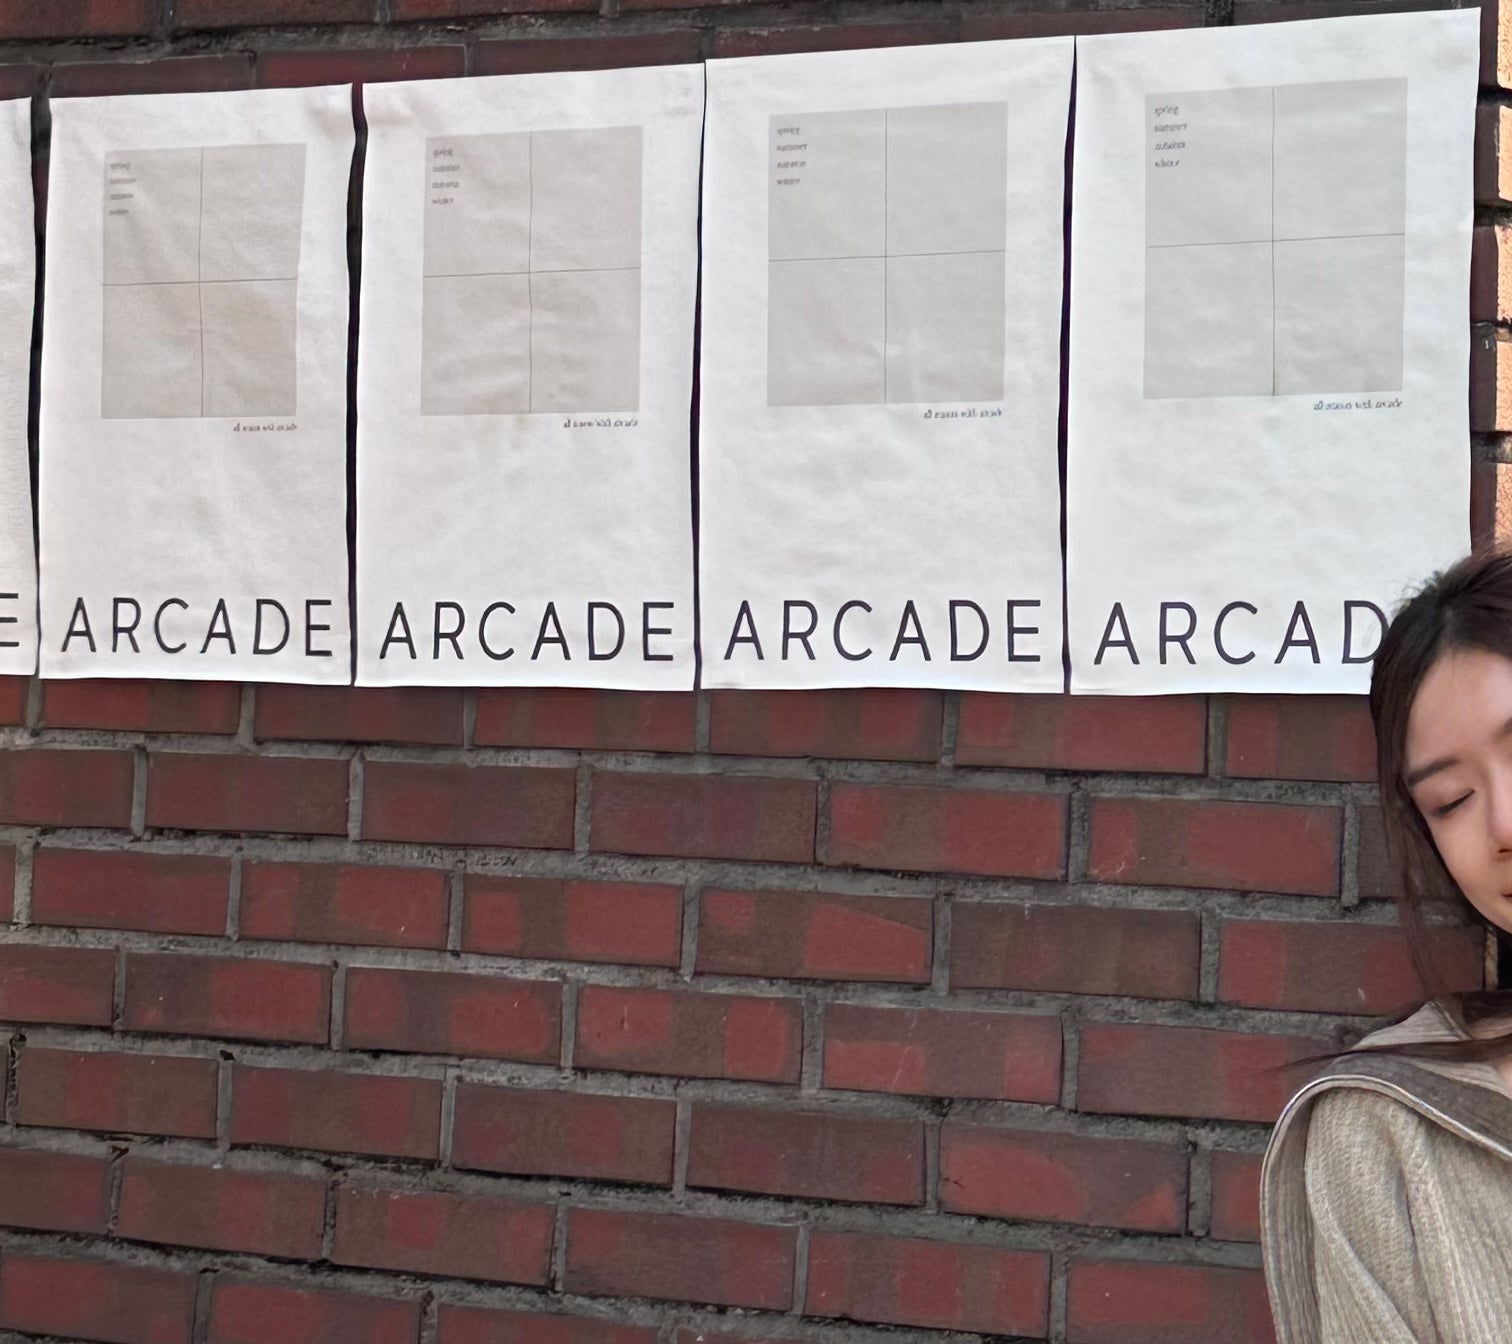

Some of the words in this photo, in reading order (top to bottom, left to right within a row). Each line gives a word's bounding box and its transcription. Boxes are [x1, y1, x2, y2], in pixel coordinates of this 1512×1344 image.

[61, 597, 333, 657] ARCADE
[379, 601, 674, 662] ARCADE
[724, 599, 1041, 662] ARCADE
[1094, 600, 1390, 665] ARCAD
